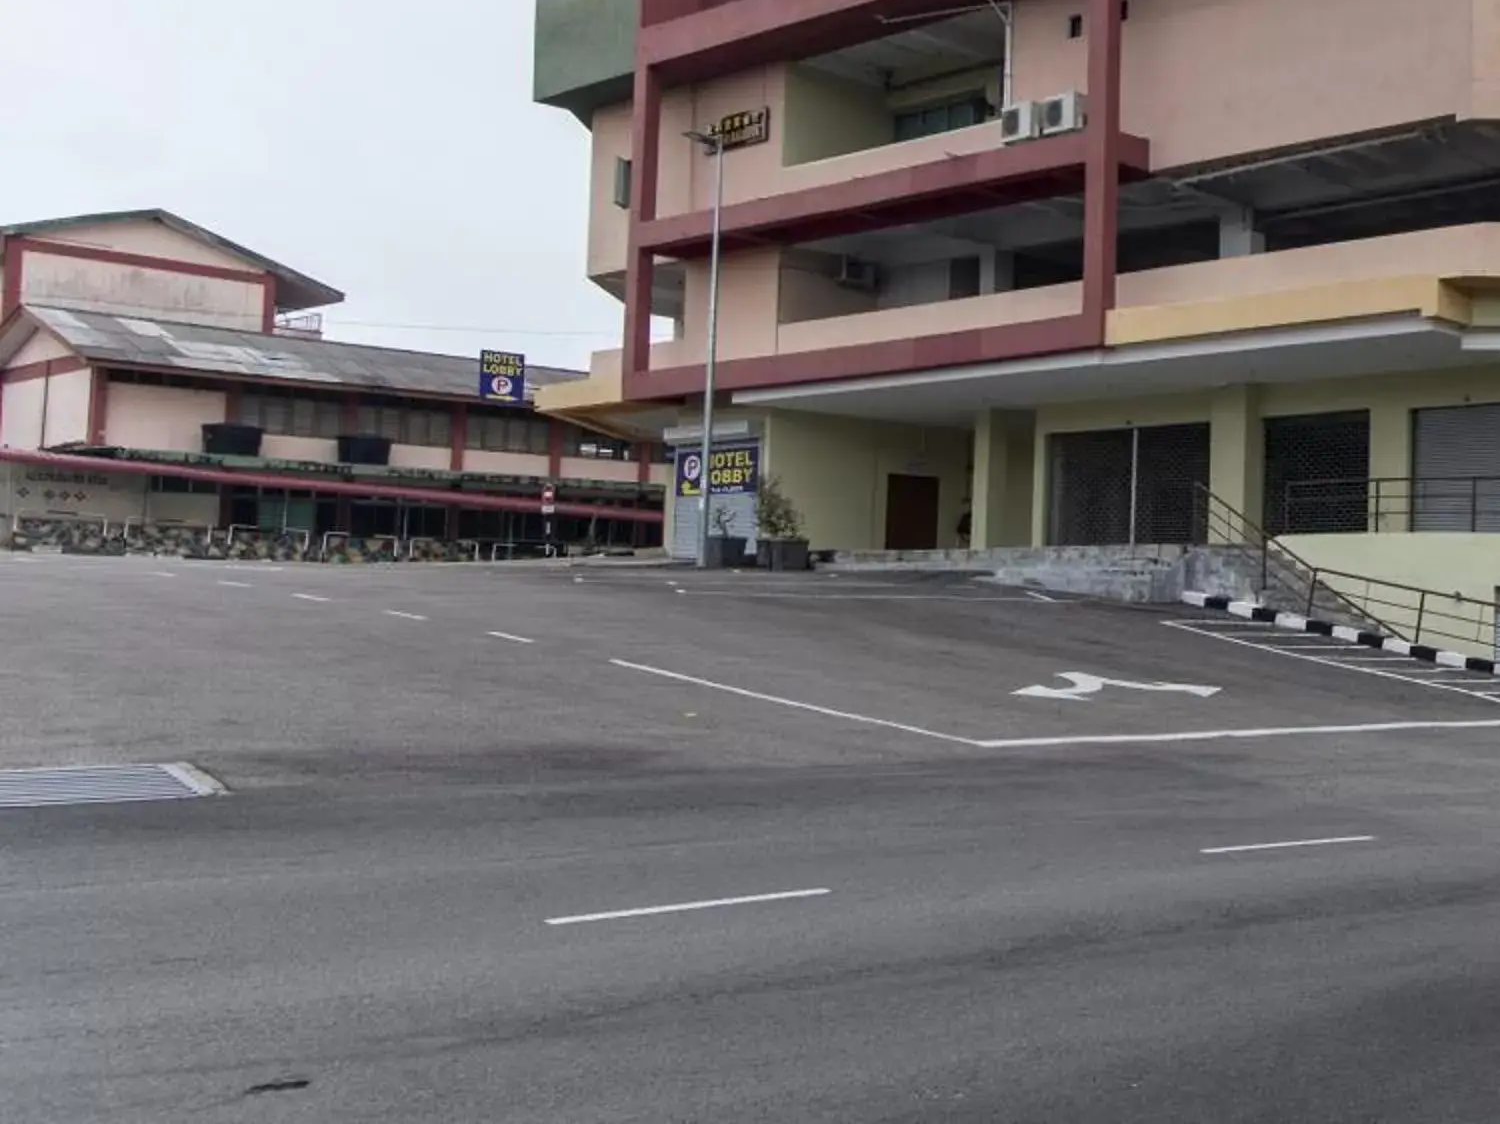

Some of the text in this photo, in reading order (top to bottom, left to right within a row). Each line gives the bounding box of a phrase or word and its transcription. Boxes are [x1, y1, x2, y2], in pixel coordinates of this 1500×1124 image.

[484, 352, 522, 366] HOTEL
[484, 364, 522, 377] LOBBY
[497, 379, 508, 391] P
[688, 458, 697, 476] P
[711, 468, 752, 485] OBBY
